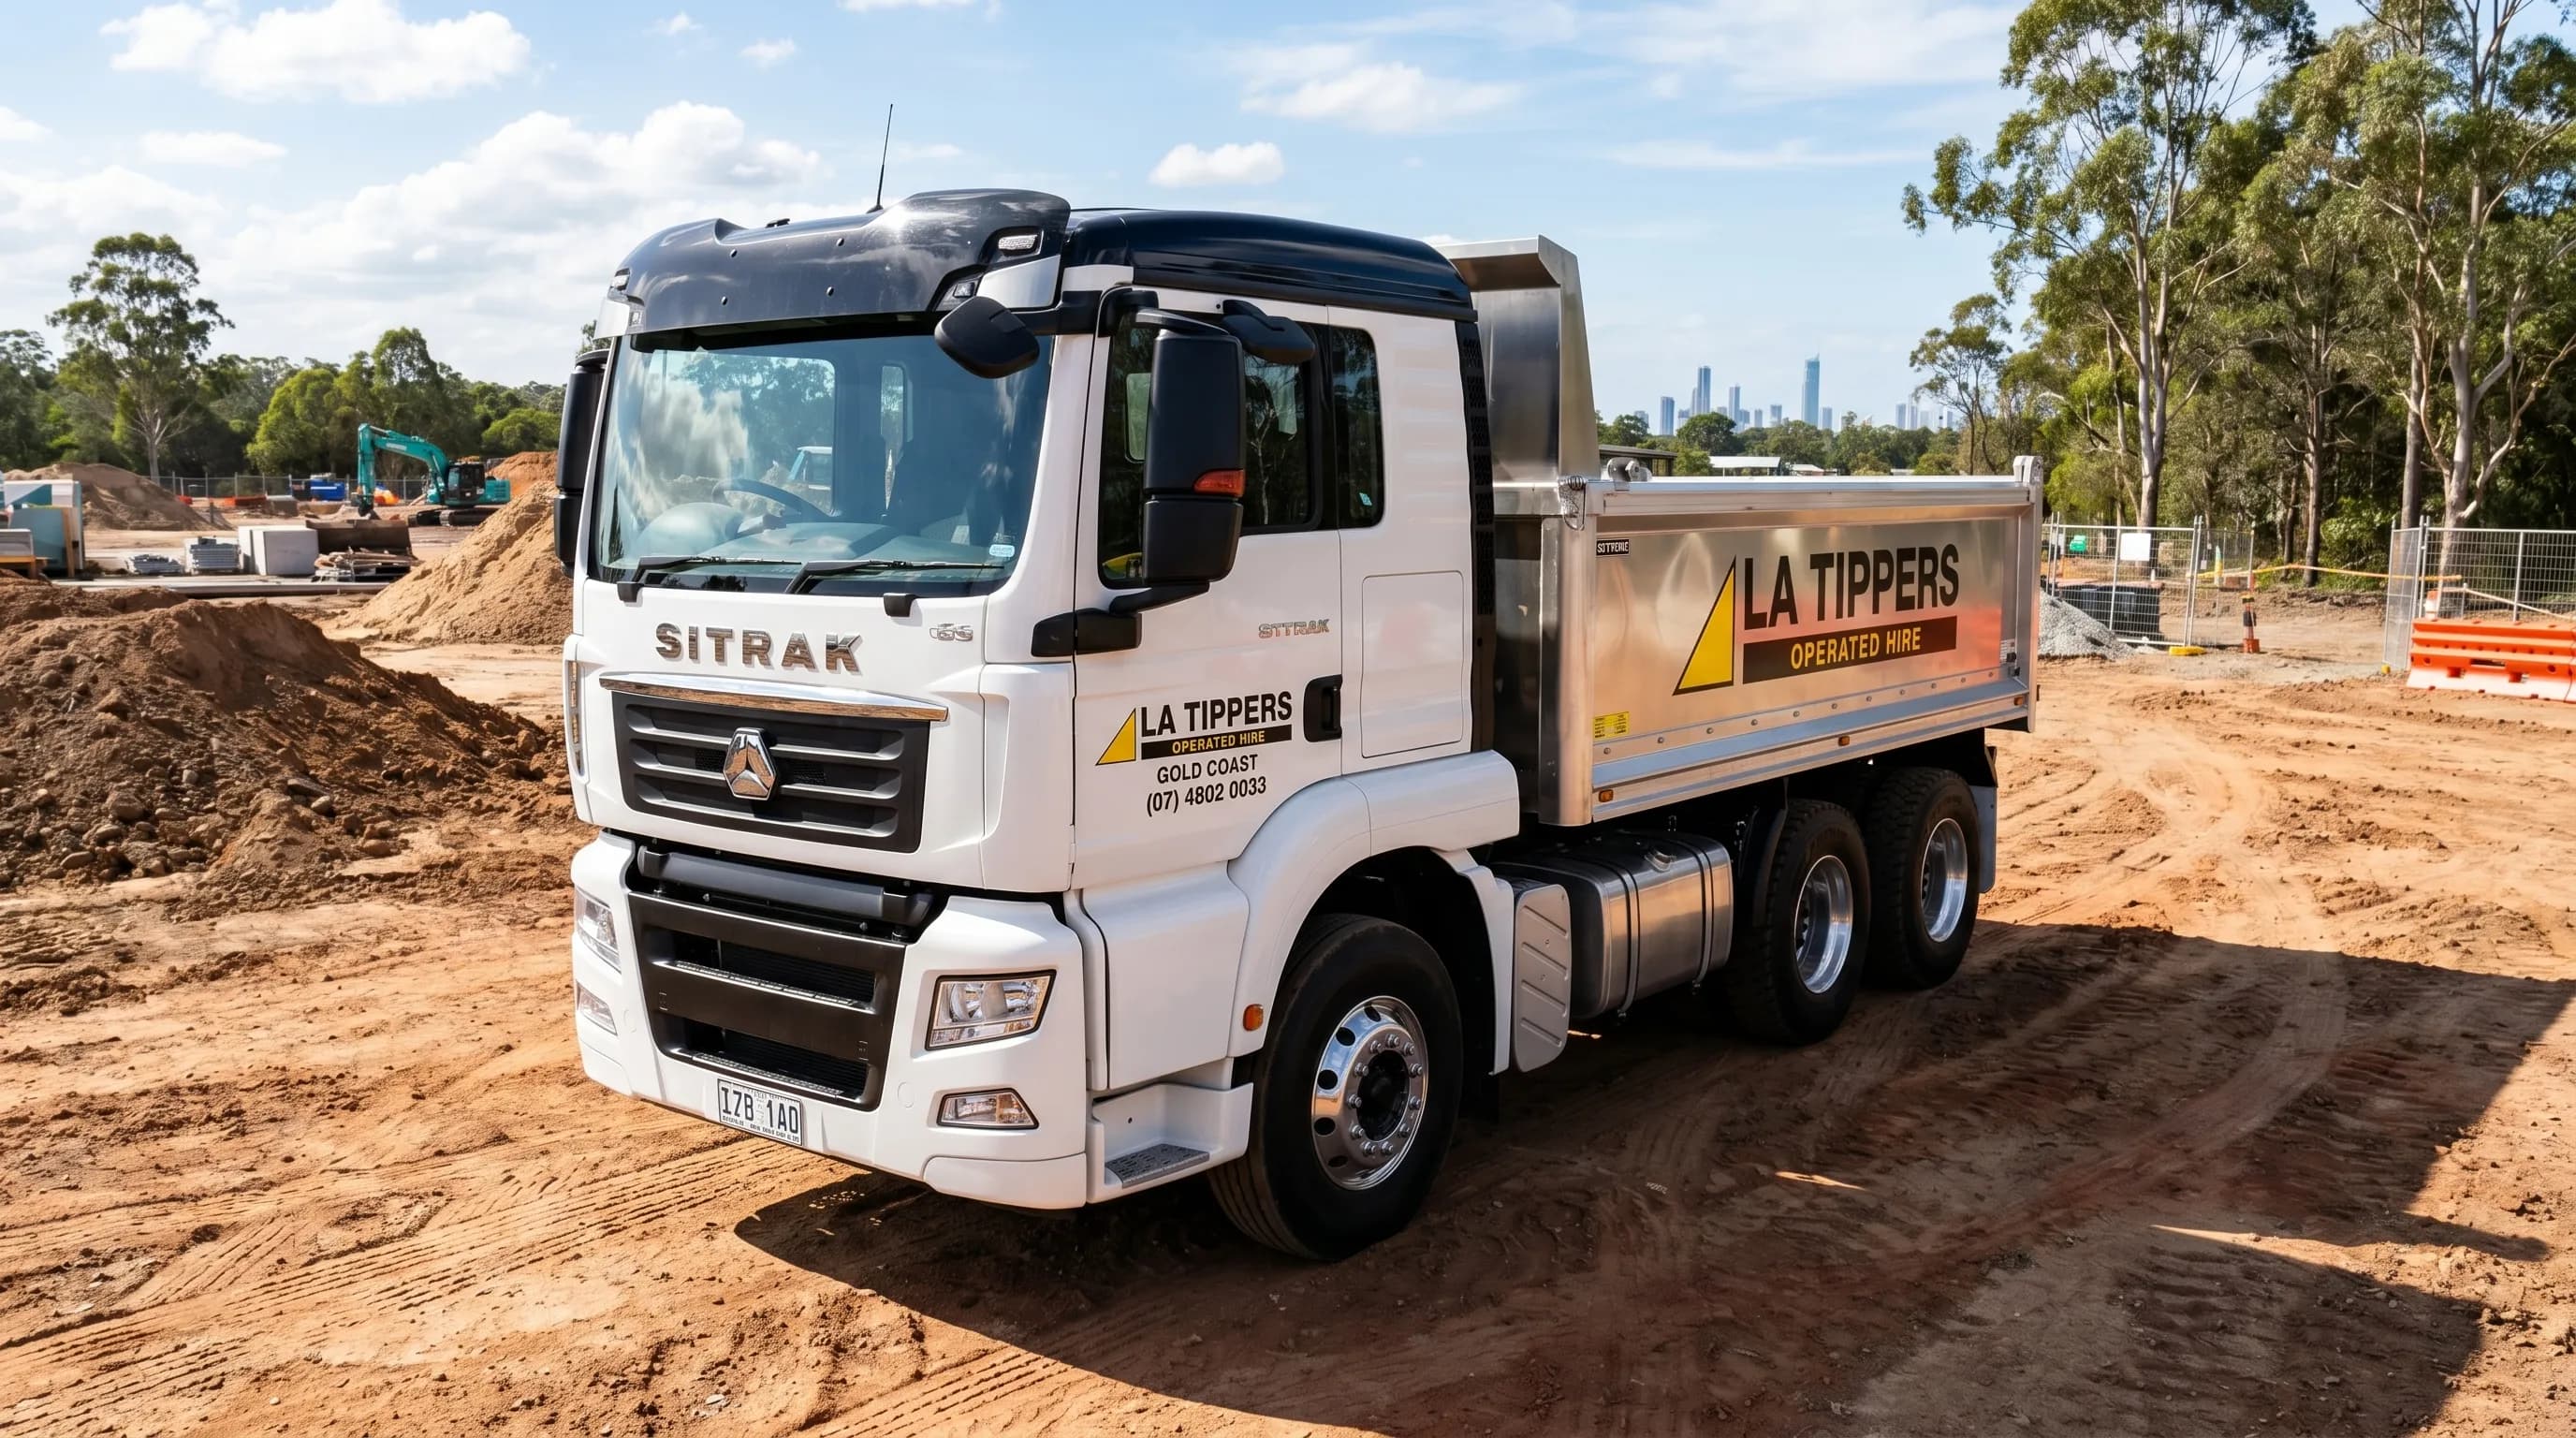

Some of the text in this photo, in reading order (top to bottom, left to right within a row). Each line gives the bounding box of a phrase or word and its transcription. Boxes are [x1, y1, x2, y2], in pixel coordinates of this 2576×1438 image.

[1744, 543, 1959, 631] LA TIPPERS
[655, 622, 863, 675] SITRAK
[1790, 626, 1922, 670] OPERATED HIRE
[1141, 691, 1293, 738] LA TIPPERS
[1172, 730, 1266, 755] OPERATED HIRE
[1157, 754, 1258, 785] GOLD COAST
[1147, 776, 1266, 817] (07) 4802 0033
